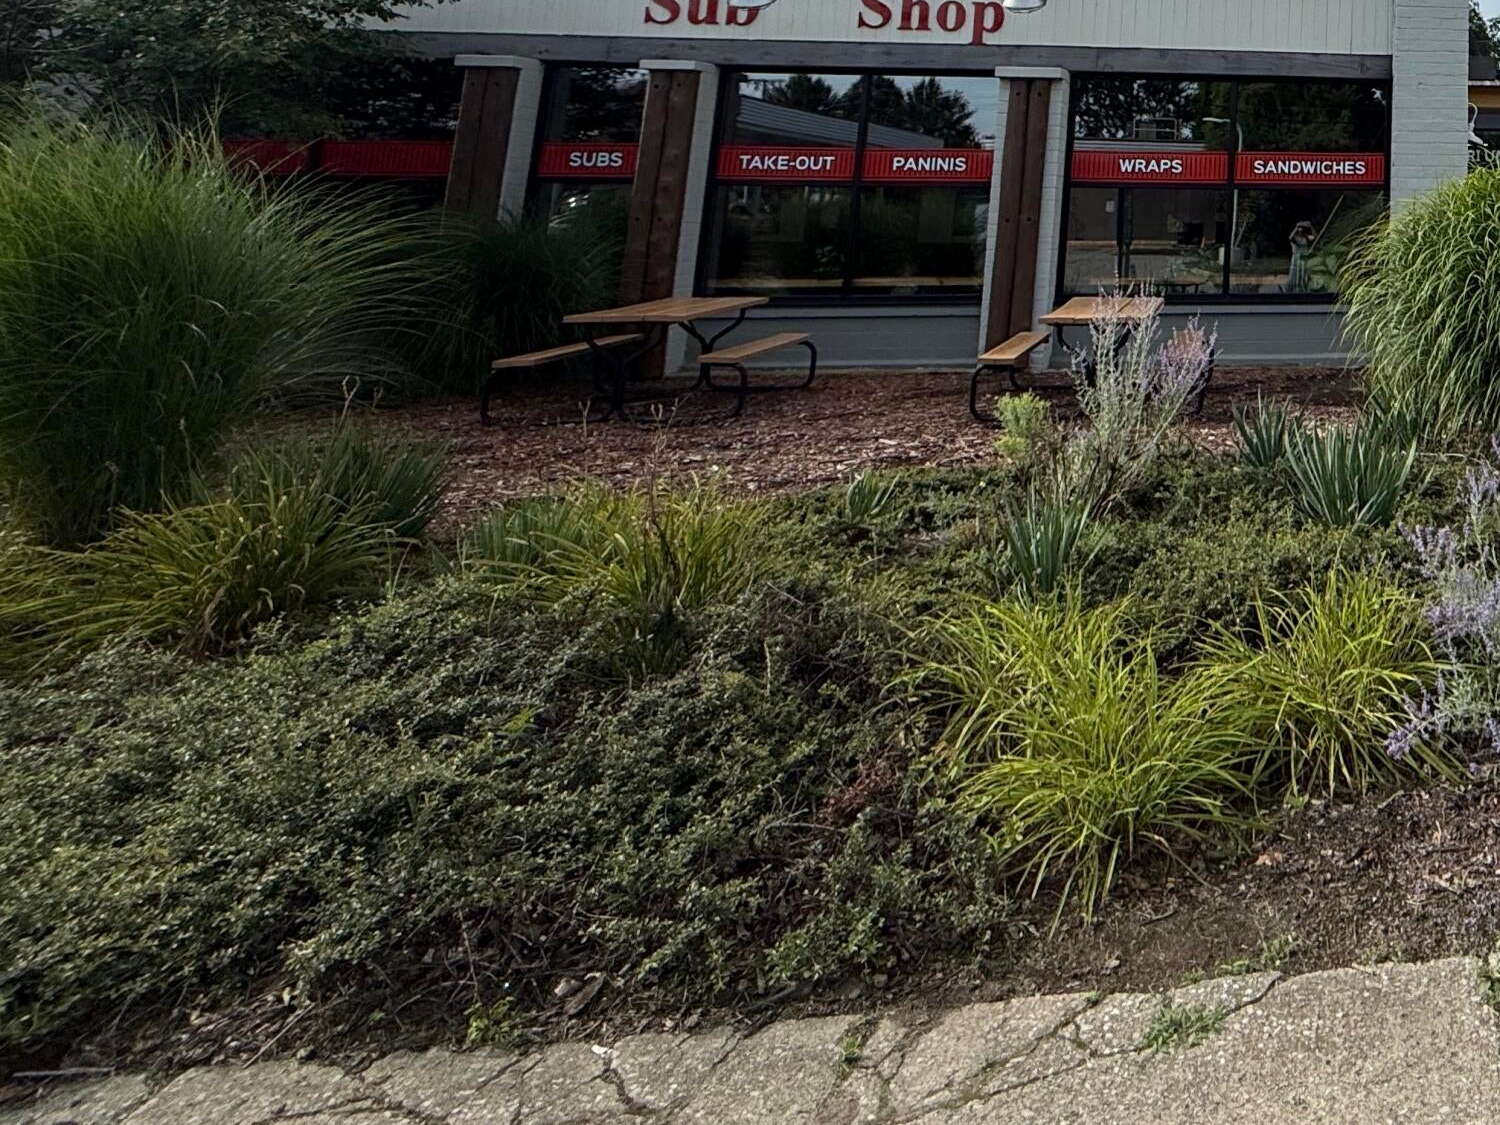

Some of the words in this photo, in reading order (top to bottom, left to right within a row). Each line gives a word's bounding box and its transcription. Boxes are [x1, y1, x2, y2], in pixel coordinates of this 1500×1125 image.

[569, 151, 623, 167] SUBS
[739, 154, 835, 172] TAKE-OUT
[892, 156, 967, 172] PANINIS
[1119, 159, 1183, 174] WRAPS
[1253, 160, 1366, 175] SANDWICHES
